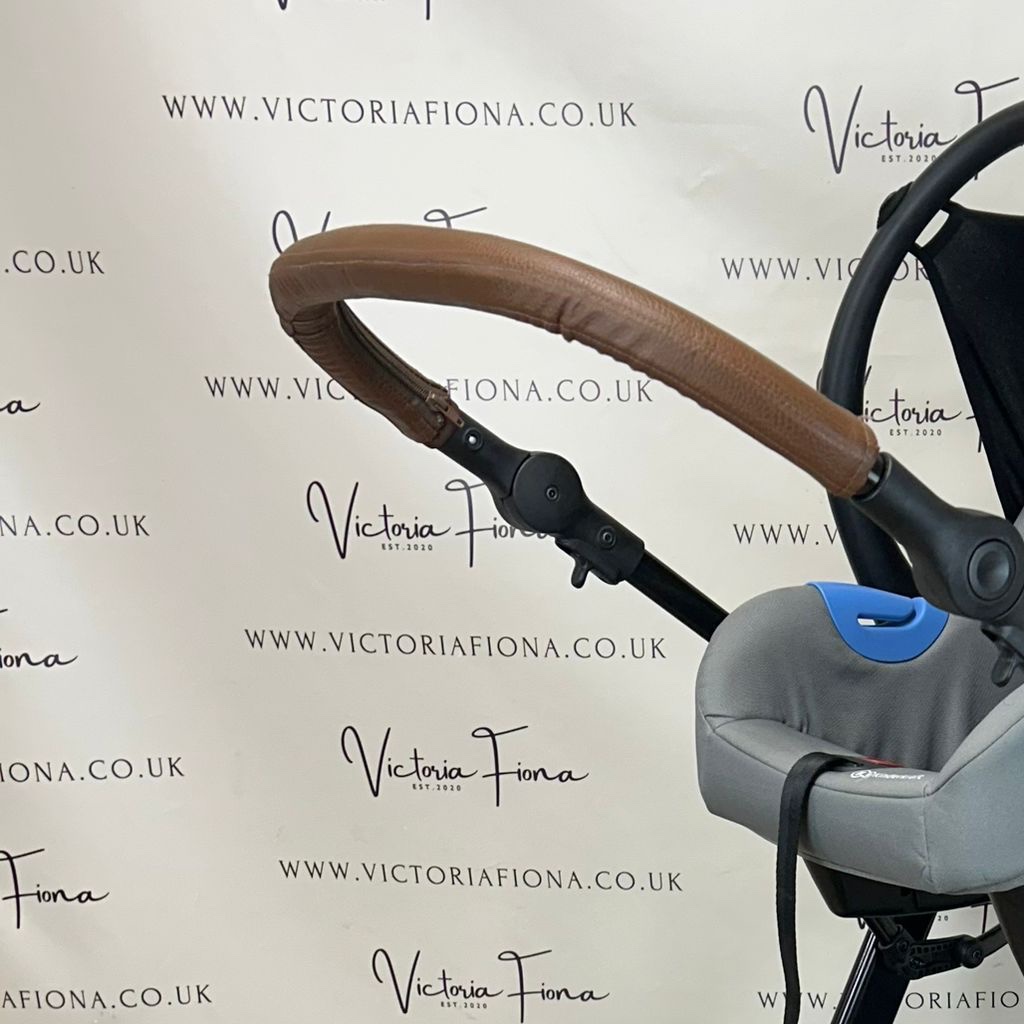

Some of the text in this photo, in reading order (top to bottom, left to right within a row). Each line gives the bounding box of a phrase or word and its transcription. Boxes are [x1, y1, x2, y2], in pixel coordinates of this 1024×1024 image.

[162, 95, 637, 128] WWW.VICTORIAFIONA.CO.UK
[804, 84, 958, 174] Victoria
[862, 366, 962, 426] ictoria
[889, 428, 943, 437] EST.2020
[306, 480, 451, 560] Victoria
[381, 543, 434, 552] EST.2020
[245, 629, 667, 660] WWW.VICTORIAFIONA.CO.UK
[341, 725, 589, 807] Victoria Fiona
[412, 783, 462, 792] EST.2020
[0, 848, 110, 929] Fiona
[279, 859, 684, 893] WWW.VICTORIAFIONA.CO.UK
[372, 949, 610, 1024] Victoria Fiona
[440, 1002, 488, 1010] EST.2020
